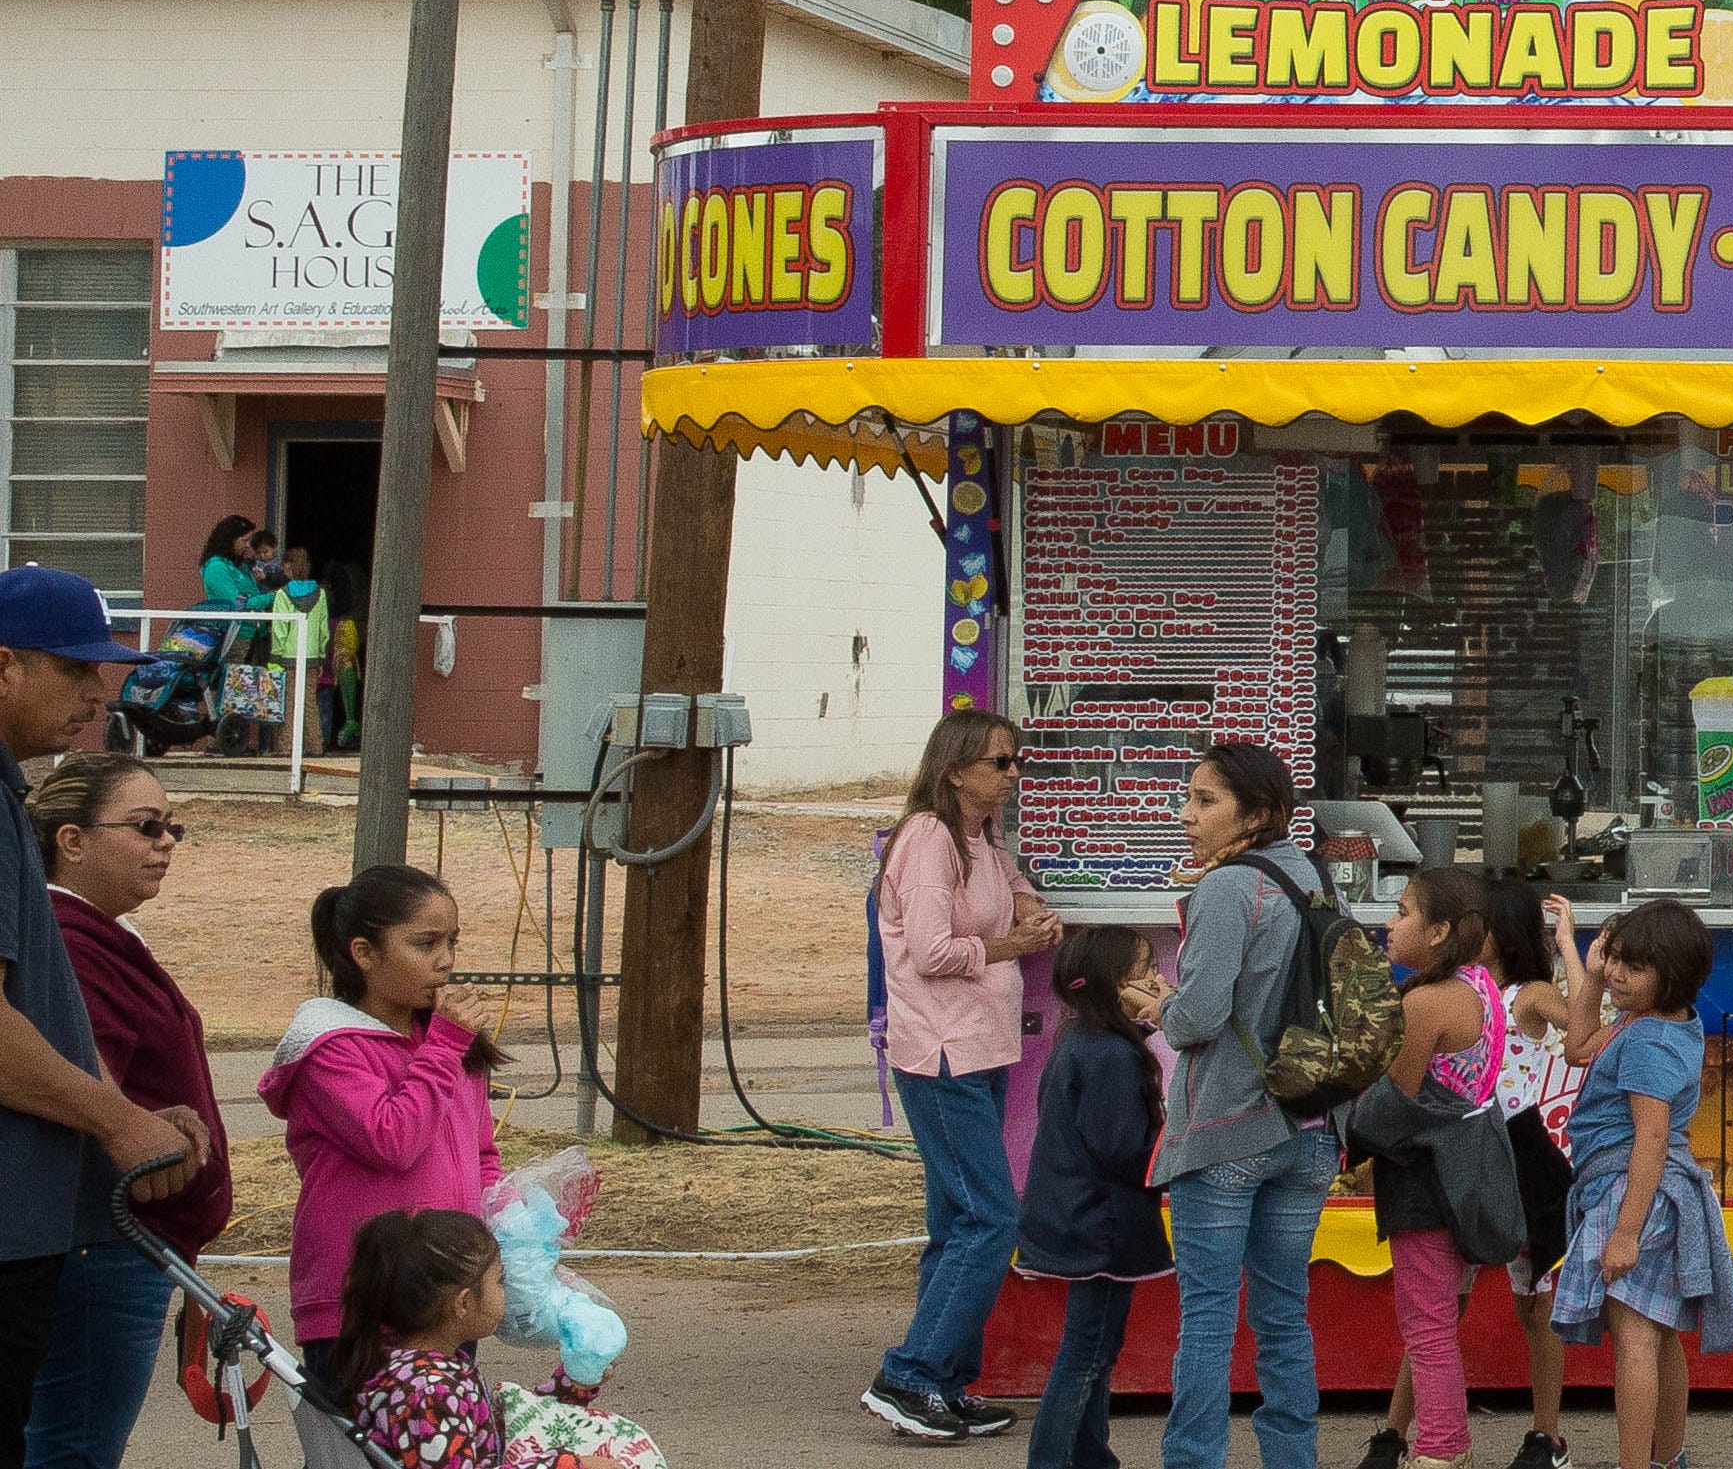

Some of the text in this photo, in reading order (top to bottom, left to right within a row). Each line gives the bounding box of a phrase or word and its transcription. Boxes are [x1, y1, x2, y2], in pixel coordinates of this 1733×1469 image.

[1153, 0, 1699, 92] LEMONADE
[305, 164, 391, 196] THE
[245, 199, 393, 248] S.A.G
[680, 182, 851, 312] CONES
[984, 183, 1358, 309] COTTON
[1380, 184, 1706, 310] CANDY
[272, 256, 394, 288] HOUS
[179, 301, 392, 319] Southwestern Art Gallery & Educatio
[1102, 423, 1238, 457] MENU
[1024, 670, 1131, 682] Lemonade
[1072, 701, 1166, 713] souvenir
[1171, 702, 1209, 715] cup
[1023, 717, 1130, 729] Lemonade
[1022, 748, 1114, 760] Fountain
[1021, 779, 1099, 791] Bottled
[1021, 794, 1140, 808] Cappuccino
[1069, 810, 1172, 823] Chocolate
[1020, 826, 1088, 838] Coffee
[1020, 842, 1125, 854] Sno Cone
